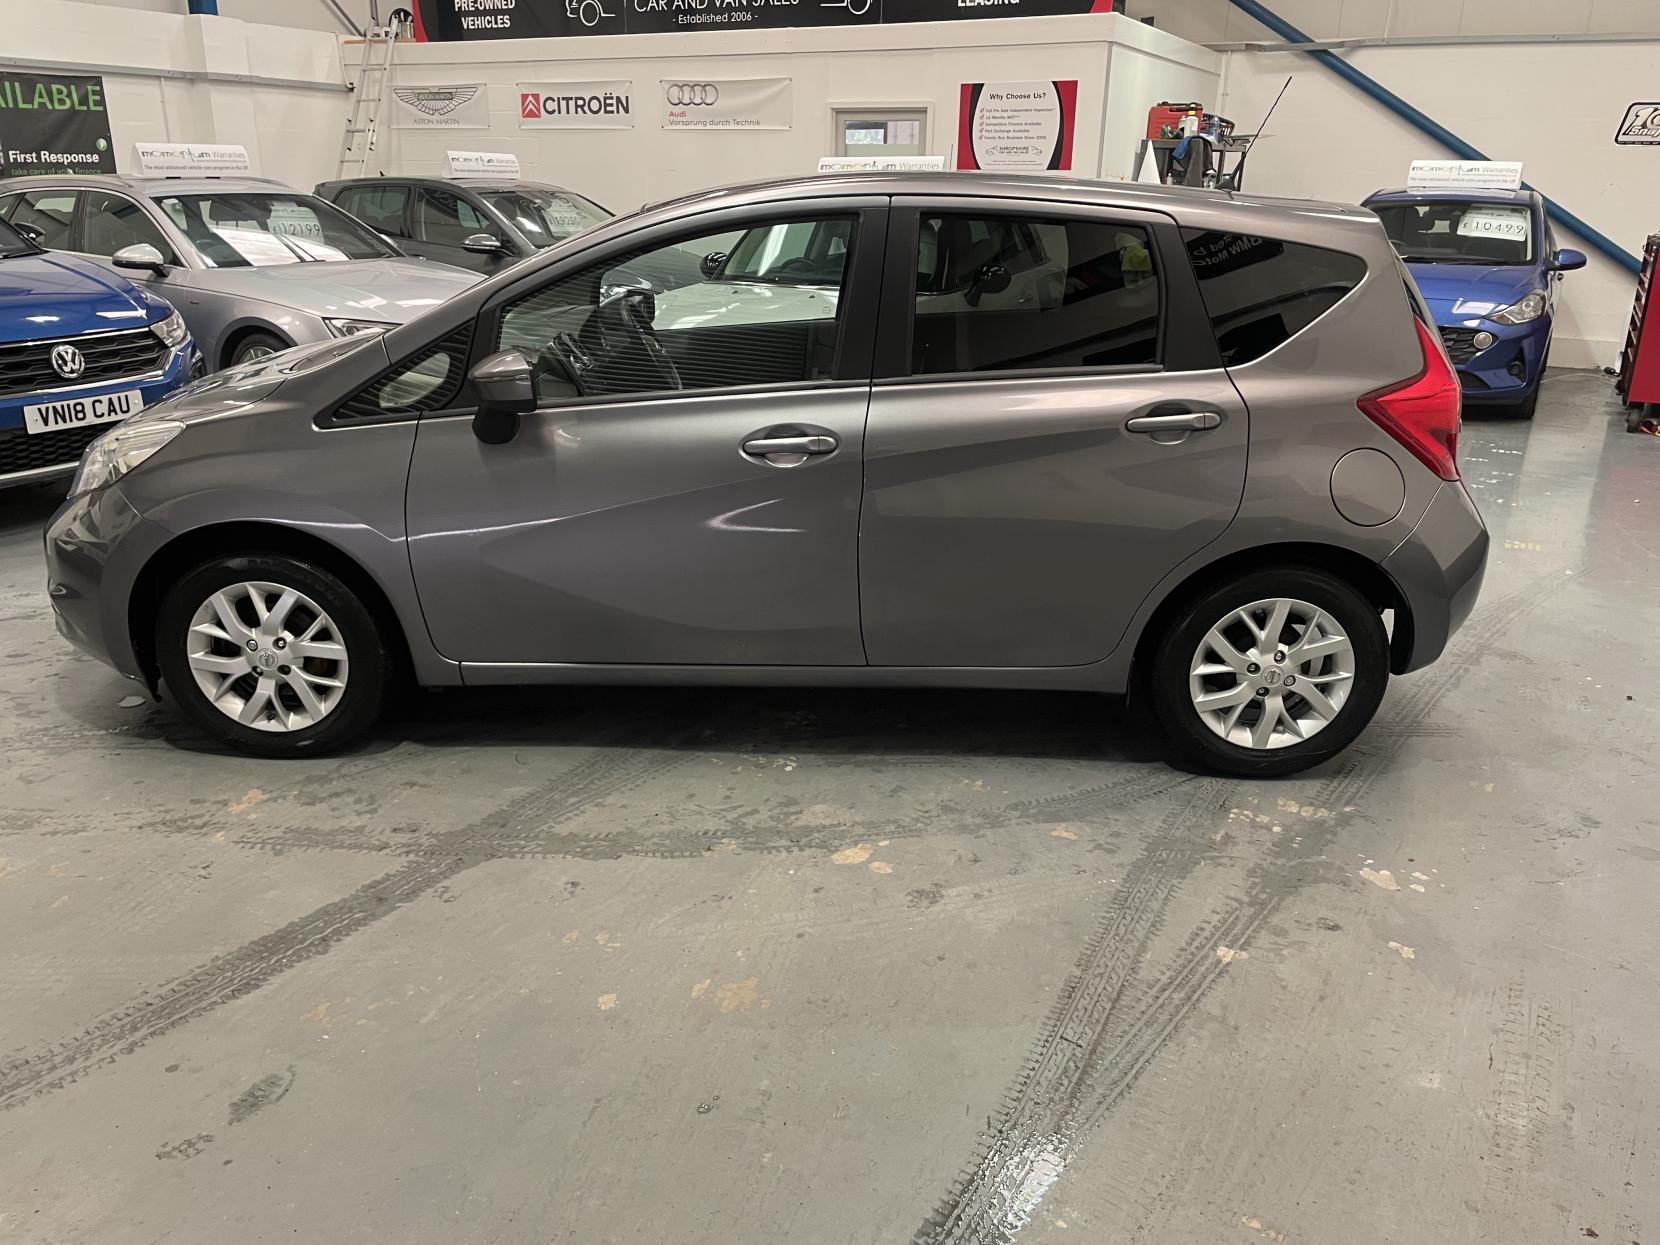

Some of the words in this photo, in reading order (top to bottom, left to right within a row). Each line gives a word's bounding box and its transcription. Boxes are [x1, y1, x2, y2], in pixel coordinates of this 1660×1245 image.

[454, 0, 516, 12] PRE-OWNED
[461, 15, 511, 30] VEHICLES
[678, 12, 728, 24] Established
[730, 12, 752, 22] 2006
[542, 92, 630, 115] CITROËN
[414, 118, 435, 126] ASTON
[435, 118, 461, 126] MARTIN
[669, 119, 708, 127] Vorsprung
[709, 118, 731, 126] durch
[732, 118, 761, 126] Technik
[8, 150, 38, 163] First
[40, 150, 100, 165] Response
[11, 167, 28, 176] take
[47, 167, 55, 175] of
[899, 161, 940, 171] Warranties
[1463, 221, 1524, 234] £10499
[37, 401, 87, 427] VN18
[91, 394, 131, 419] CAU
